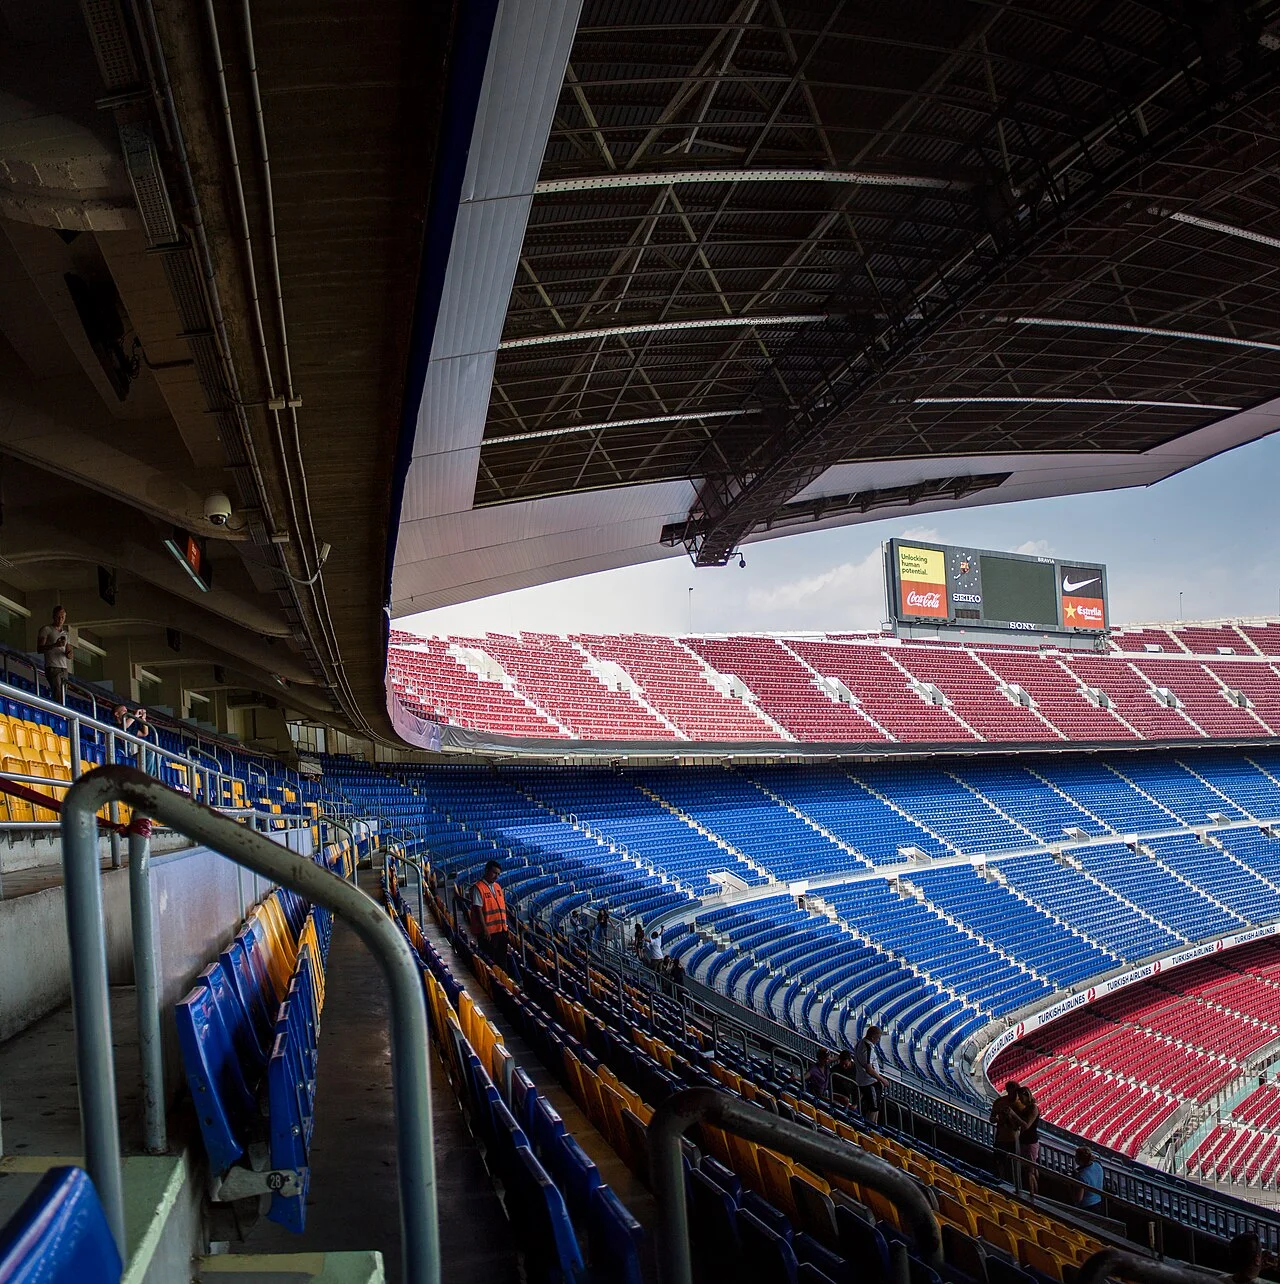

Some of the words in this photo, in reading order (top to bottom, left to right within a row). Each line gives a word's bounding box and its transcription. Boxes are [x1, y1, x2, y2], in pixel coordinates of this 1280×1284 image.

[901, 554, 928, 564] Unlocking
[952, 593, 981, 603] SEIKO
[1009, 621, 1036, 630] SONY
[1234, 932, 1254, 944] TURKISH
[1255, 926, 1275, 937] AIRLINES
[1172, 952, 1192, 965] TURKISH
[1107, 975, 1129, 992] TURKISH
[1129, 966, 1151, 982] AIRLINES
[1038, 1005, 1061, 1025] TURKISH
[1061, 994, 1085, 1013] AIRLINES
[270, 1174, 281, 1188] 28
